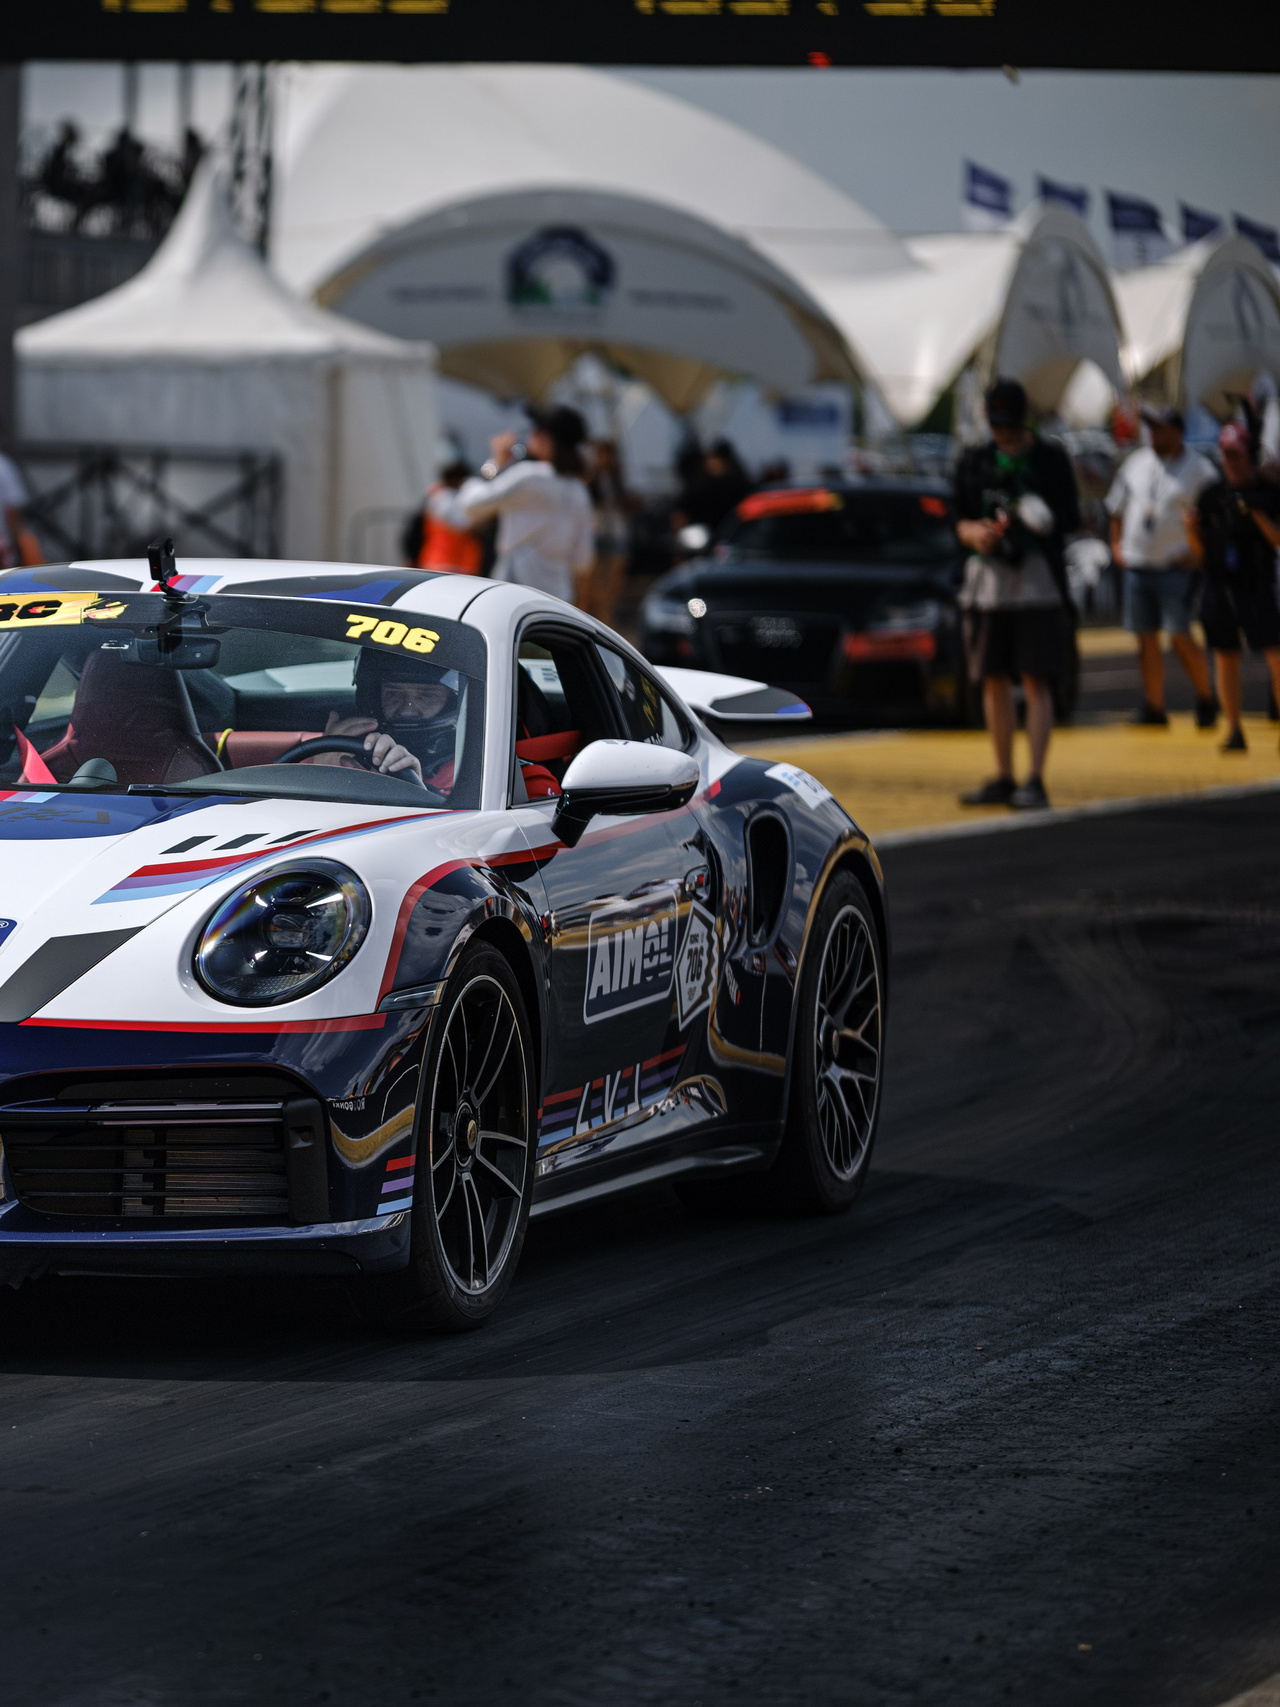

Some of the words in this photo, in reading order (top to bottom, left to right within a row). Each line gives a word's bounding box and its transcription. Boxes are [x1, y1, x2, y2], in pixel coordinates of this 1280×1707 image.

[345, 613, 441, 654] 706
[588, 917, 673, 1000] AIMOL
[685, 945, 705, 984] 706
